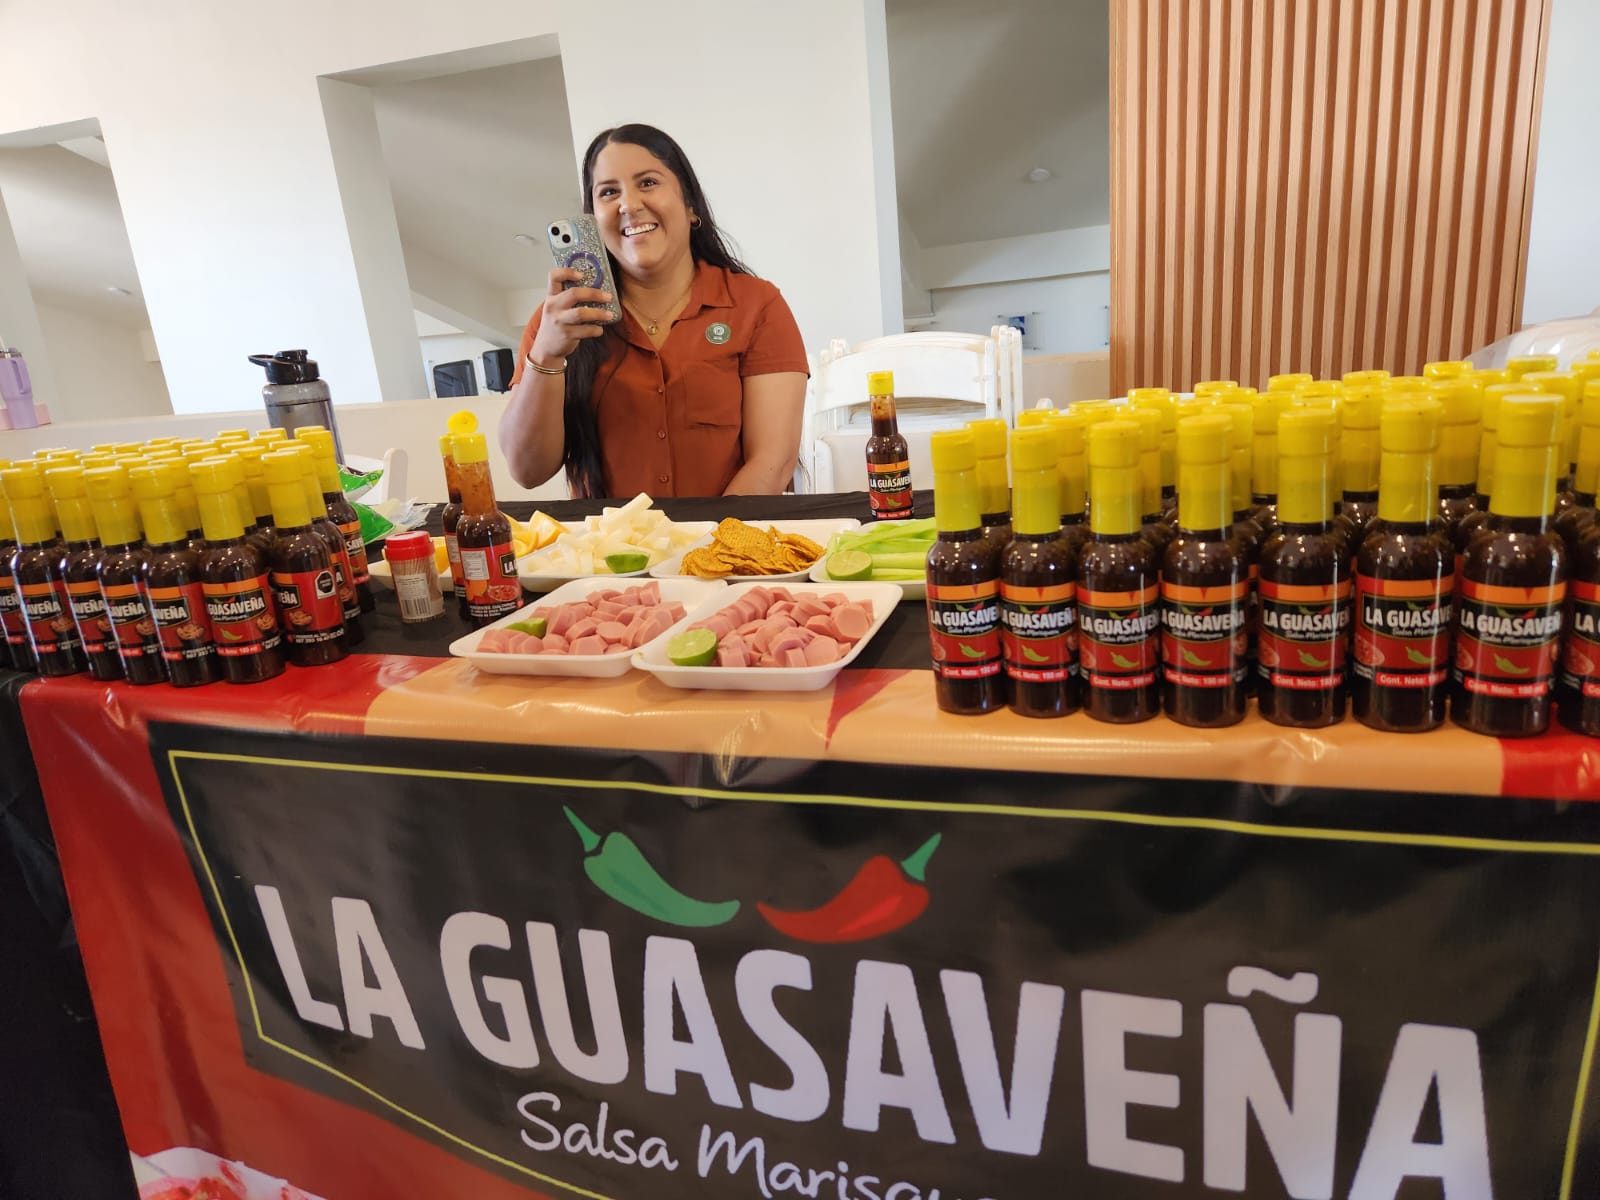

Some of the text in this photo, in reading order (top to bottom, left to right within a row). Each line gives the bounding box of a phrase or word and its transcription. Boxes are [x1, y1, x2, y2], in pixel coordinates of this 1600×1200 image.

[930, 609, 942, 625] LA
[1081, 614, 1093, 632] LA
[1263, 609, 1278, 628] LA
[1365, 606, 1384, 626] LA
[1461, 609, 1475, 630] LA
[1575, 612, 1595, 633] LA
[254, 884, 1494, 1200] LA GUASAVEÑA
[516, 1091, 679, 1171] Salsa
